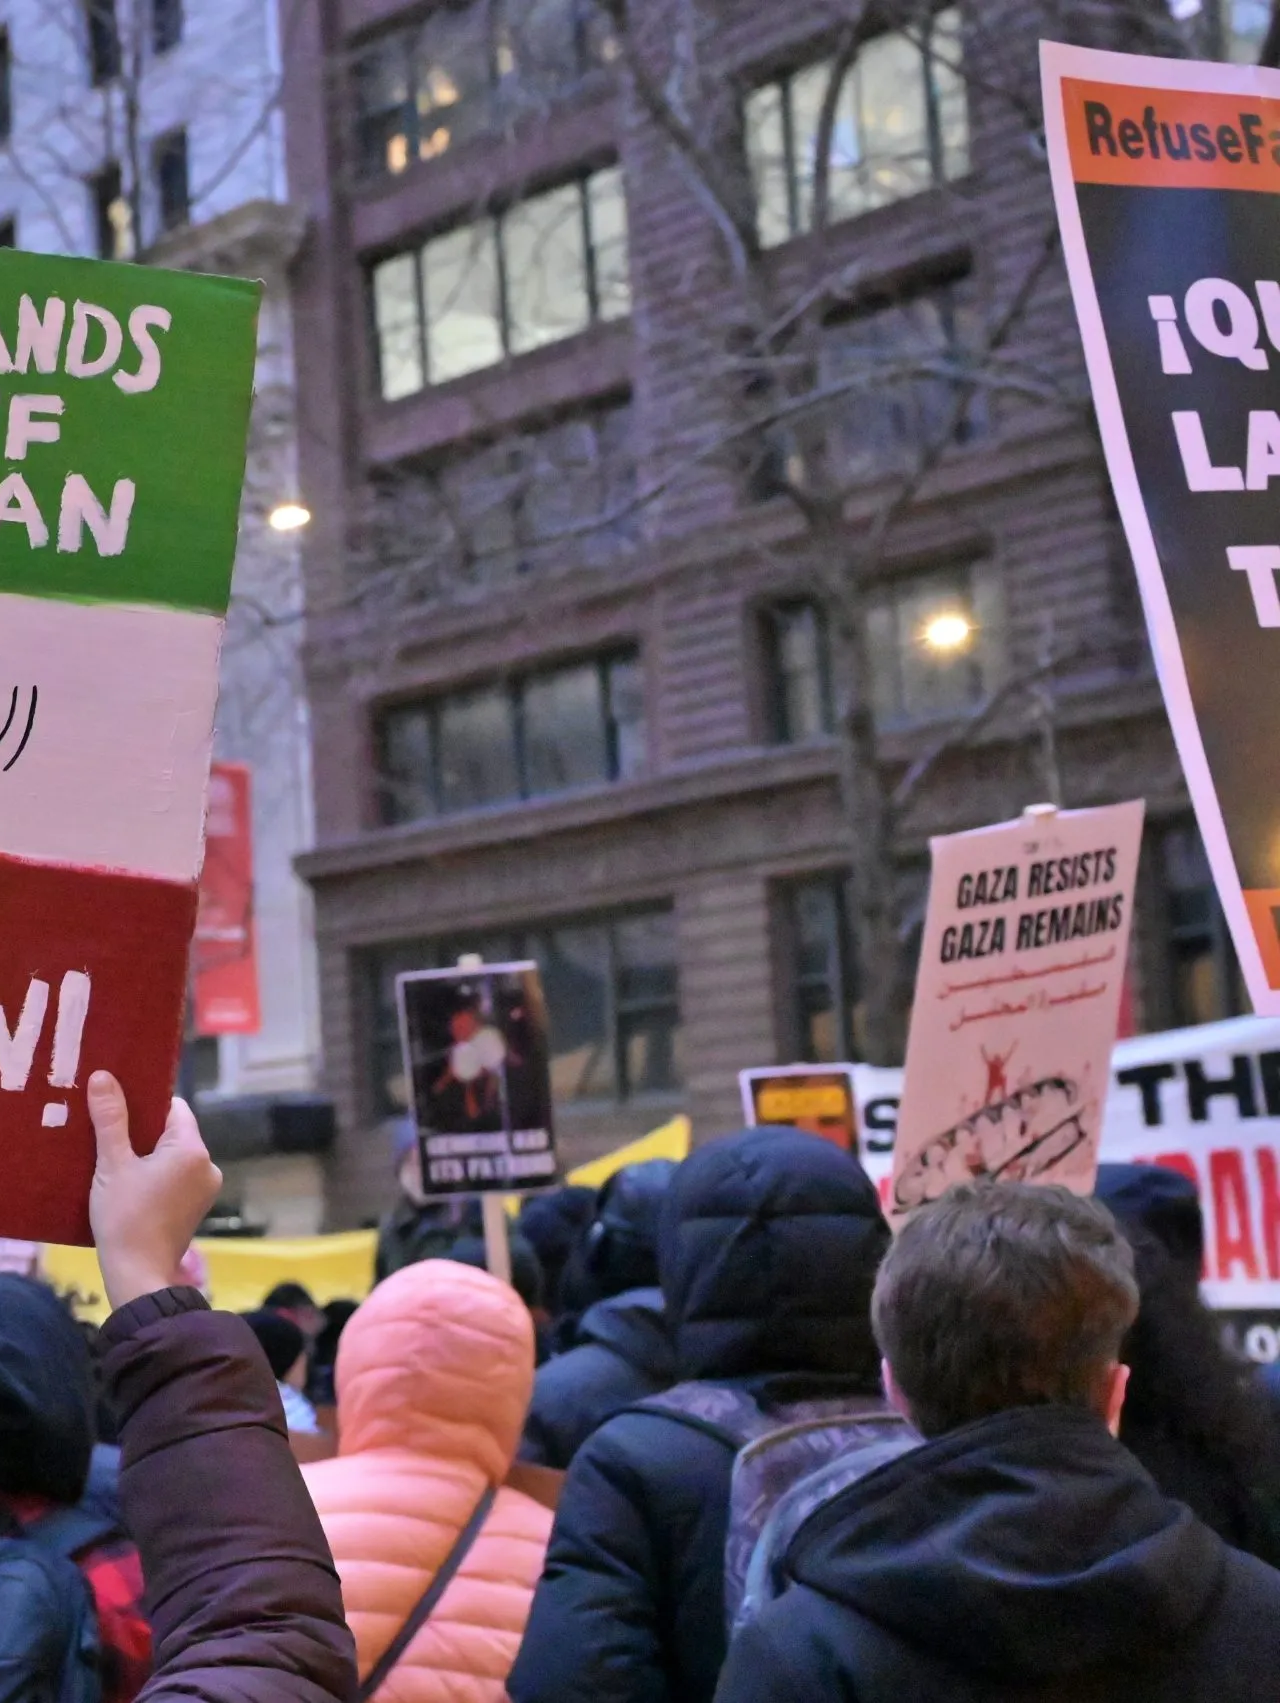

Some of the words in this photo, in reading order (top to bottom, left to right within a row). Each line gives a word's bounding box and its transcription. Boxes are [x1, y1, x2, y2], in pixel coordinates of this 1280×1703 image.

[956, 865, 1019, 909] GAZA
[1027, 847, 1118, 898] RESISTS
[940, 916, 1006, 964] GAZA
[1016, 893, 1124, 950] REMAINS
